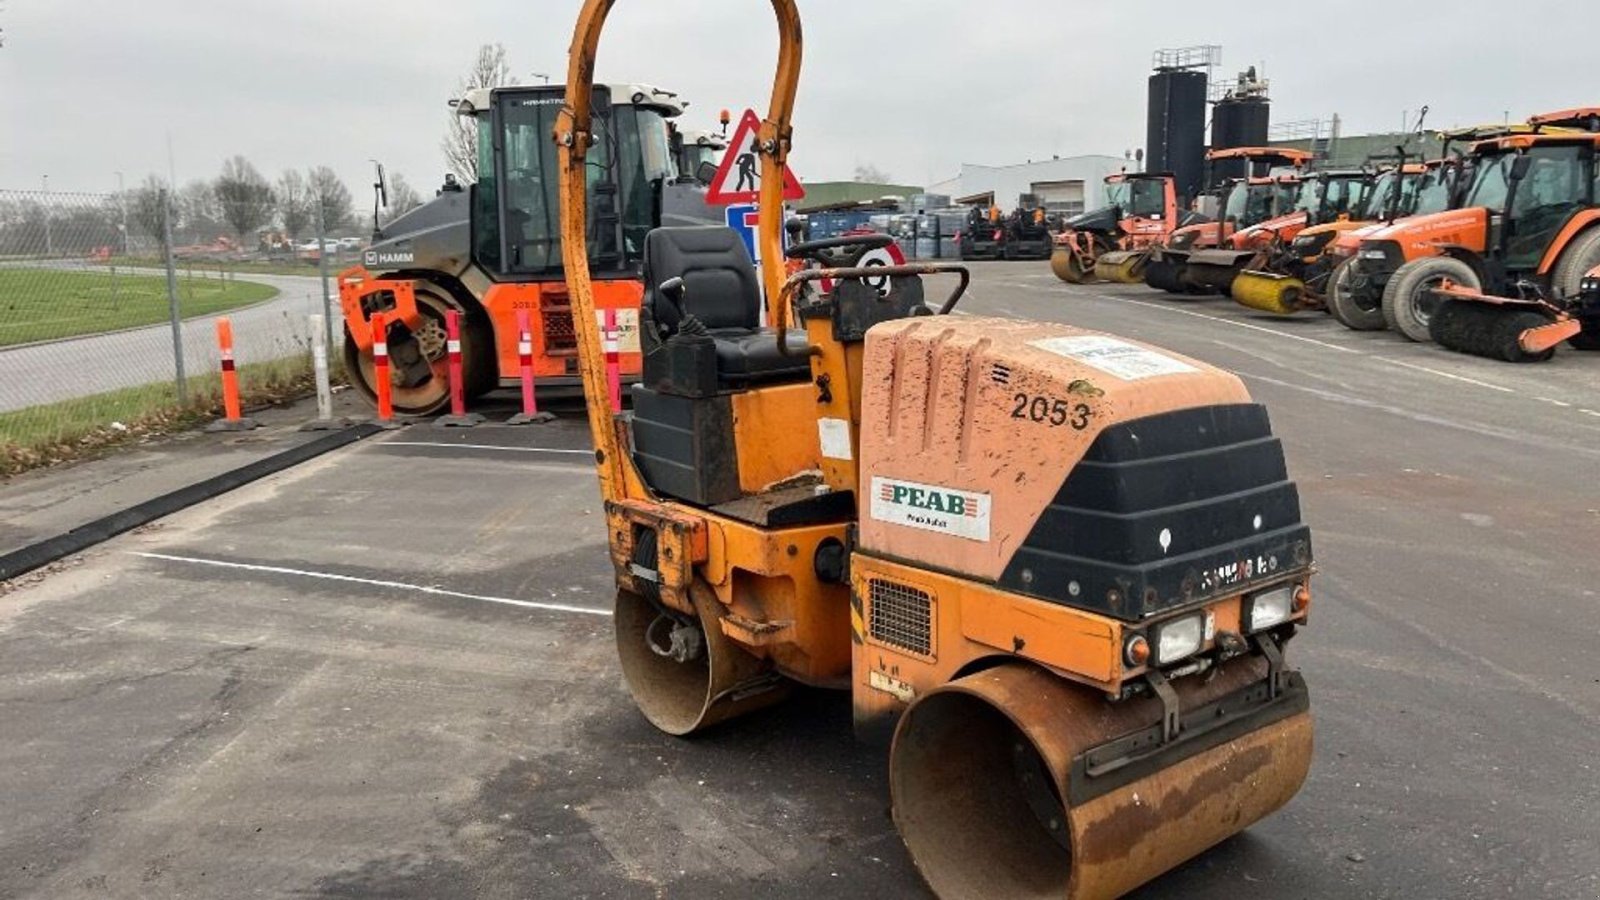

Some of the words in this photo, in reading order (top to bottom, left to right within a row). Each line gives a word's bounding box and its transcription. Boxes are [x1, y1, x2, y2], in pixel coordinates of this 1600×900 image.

[379, 253, 414, 262] HAMM
[1011, 393, 1090, 430] 2053
[892, 484, 965, 515] PEAB
